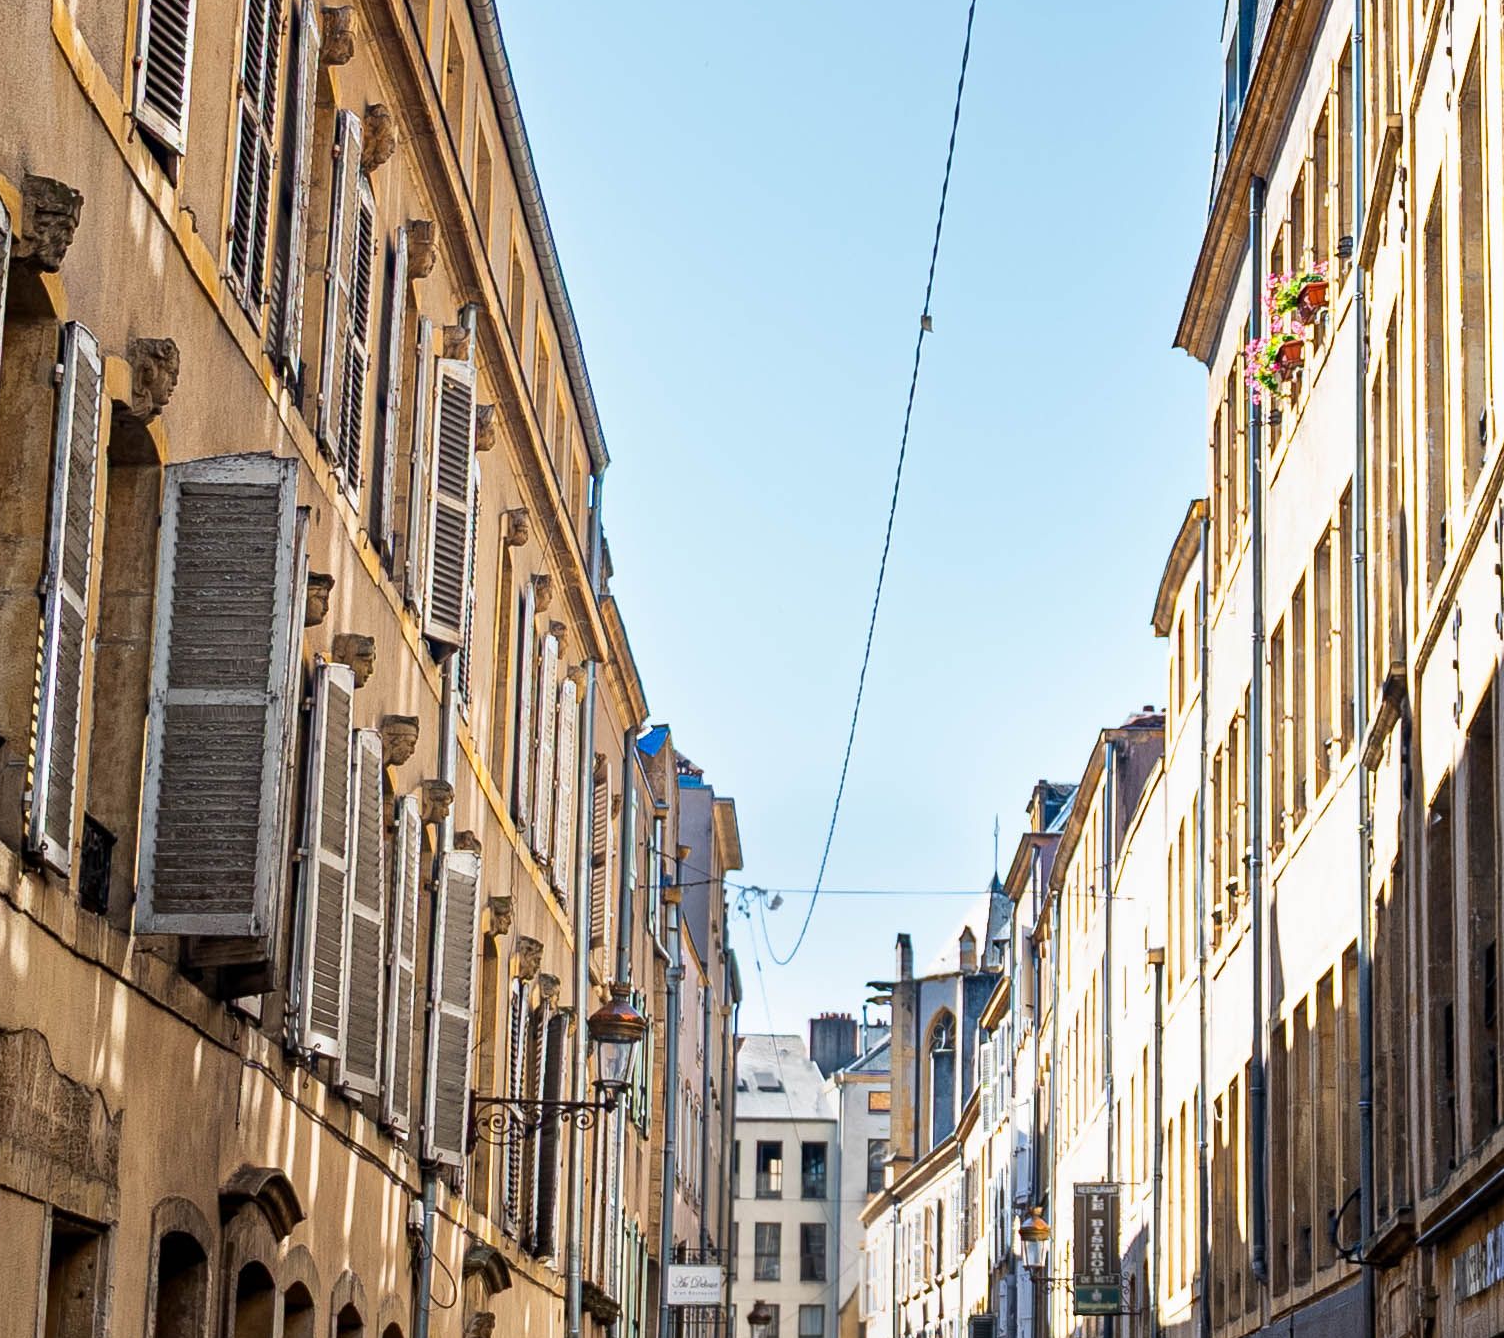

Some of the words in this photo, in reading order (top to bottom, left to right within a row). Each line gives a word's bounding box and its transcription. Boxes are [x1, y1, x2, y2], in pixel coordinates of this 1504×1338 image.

[1077, 1186, 1117, 1194] RESTAURANT
[1091, 1194, 1104, 1210] LE
[1091, 1219, 1104, 1275] BISTROT
[1081, 1275, 1090, 1283] DE
[1094, 1275, 1115, 1283] METZ
